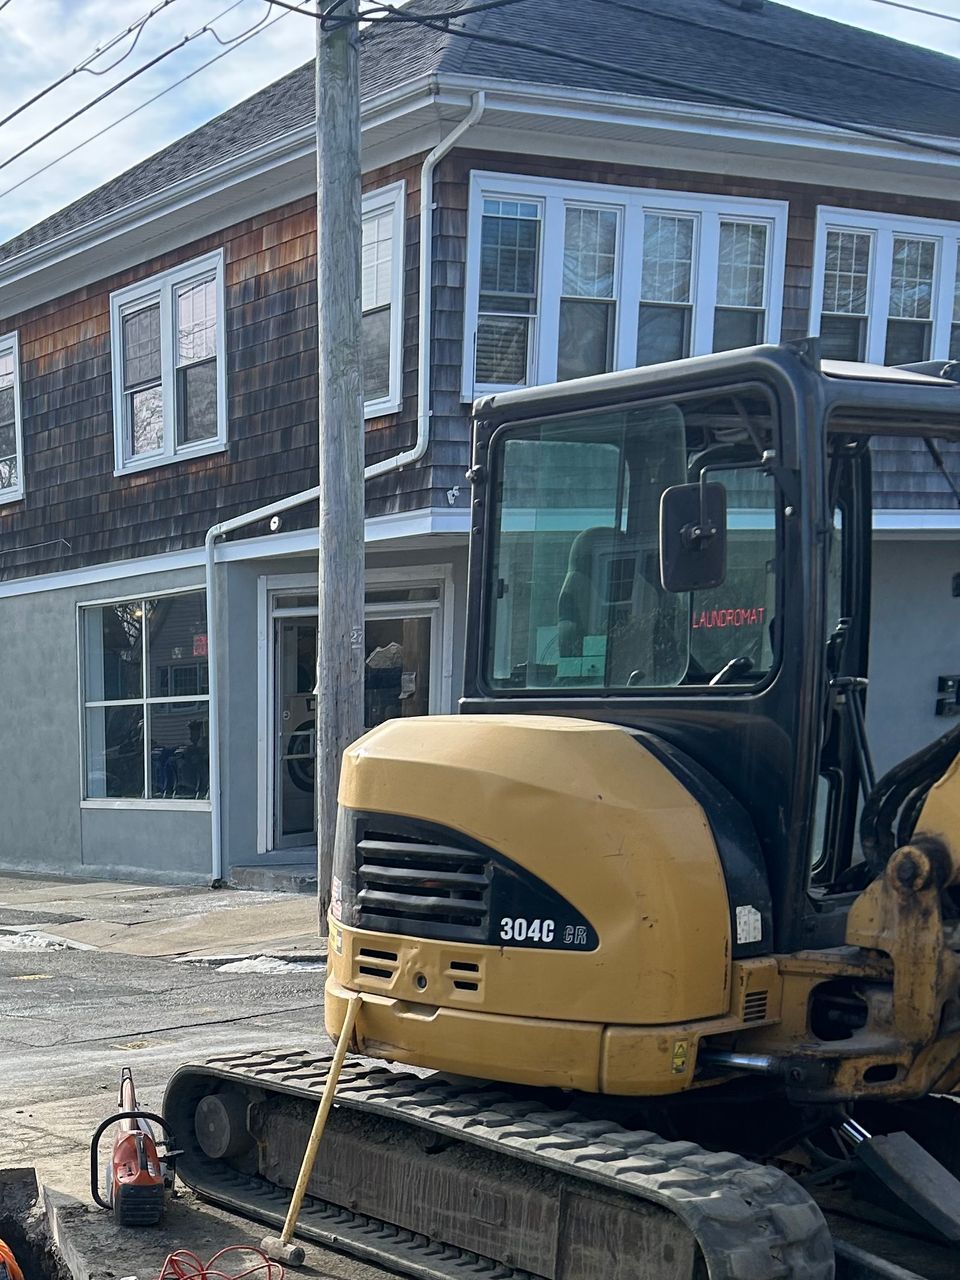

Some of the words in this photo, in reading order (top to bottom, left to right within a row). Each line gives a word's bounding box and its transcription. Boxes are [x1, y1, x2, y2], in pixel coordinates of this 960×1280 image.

[692, 607, 765, 628] LAUNDROMAT
[350, 630, 363, 643] 27
[500, 917, 555, 943] 304C
[563, 925, 587, 944] CR
